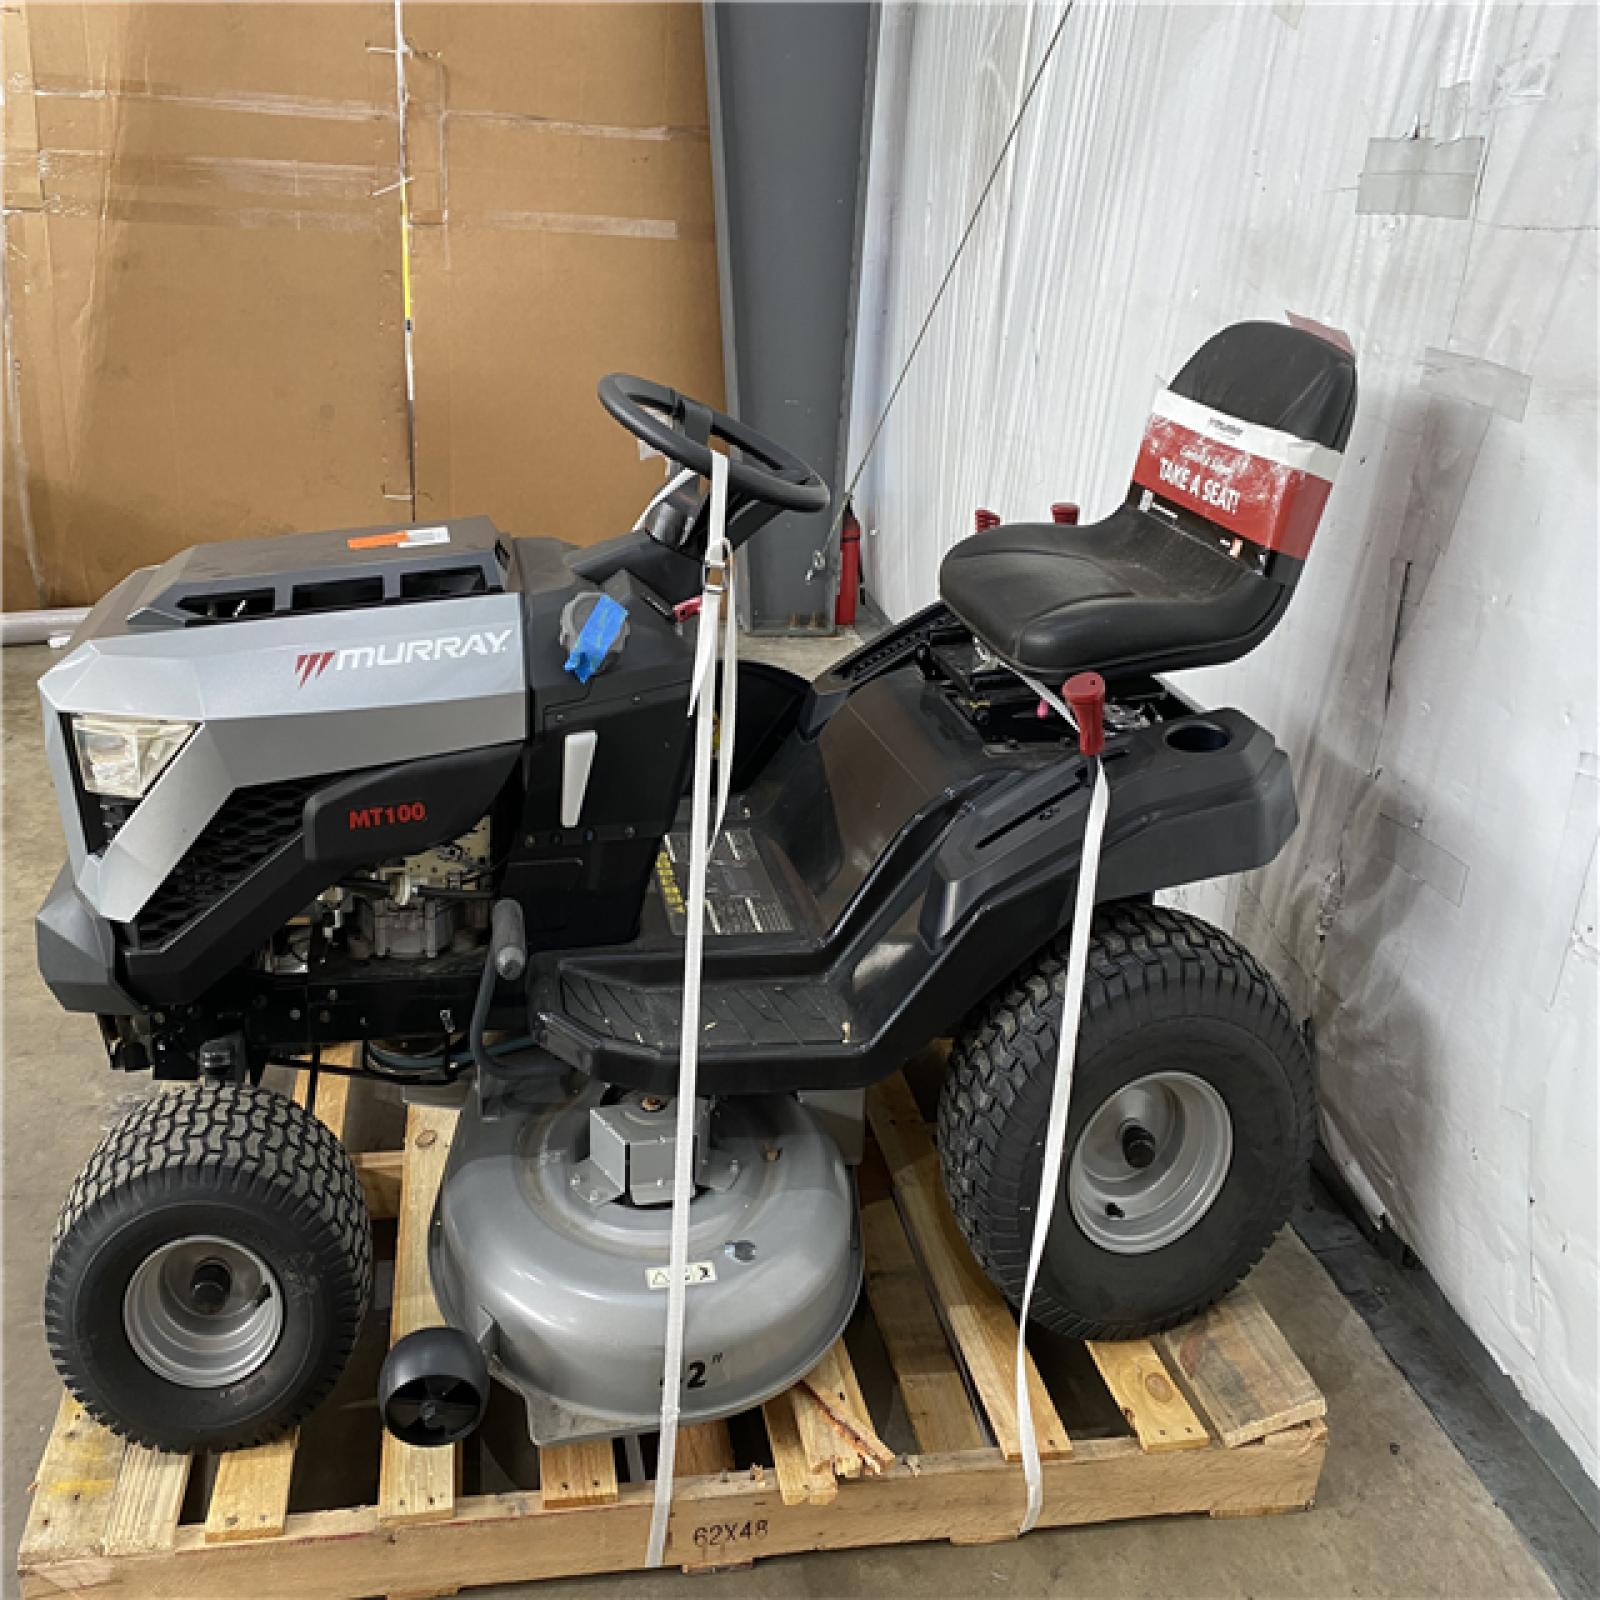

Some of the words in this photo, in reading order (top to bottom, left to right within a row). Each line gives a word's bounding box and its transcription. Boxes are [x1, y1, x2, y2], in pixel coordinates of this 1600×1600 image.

[1159, 457, 1190, 491] TAKE
[1189, 474, 1201, 498] A
[336, 629, 512, 671] MURRAY
[349, 802, 426, 832] MT100
